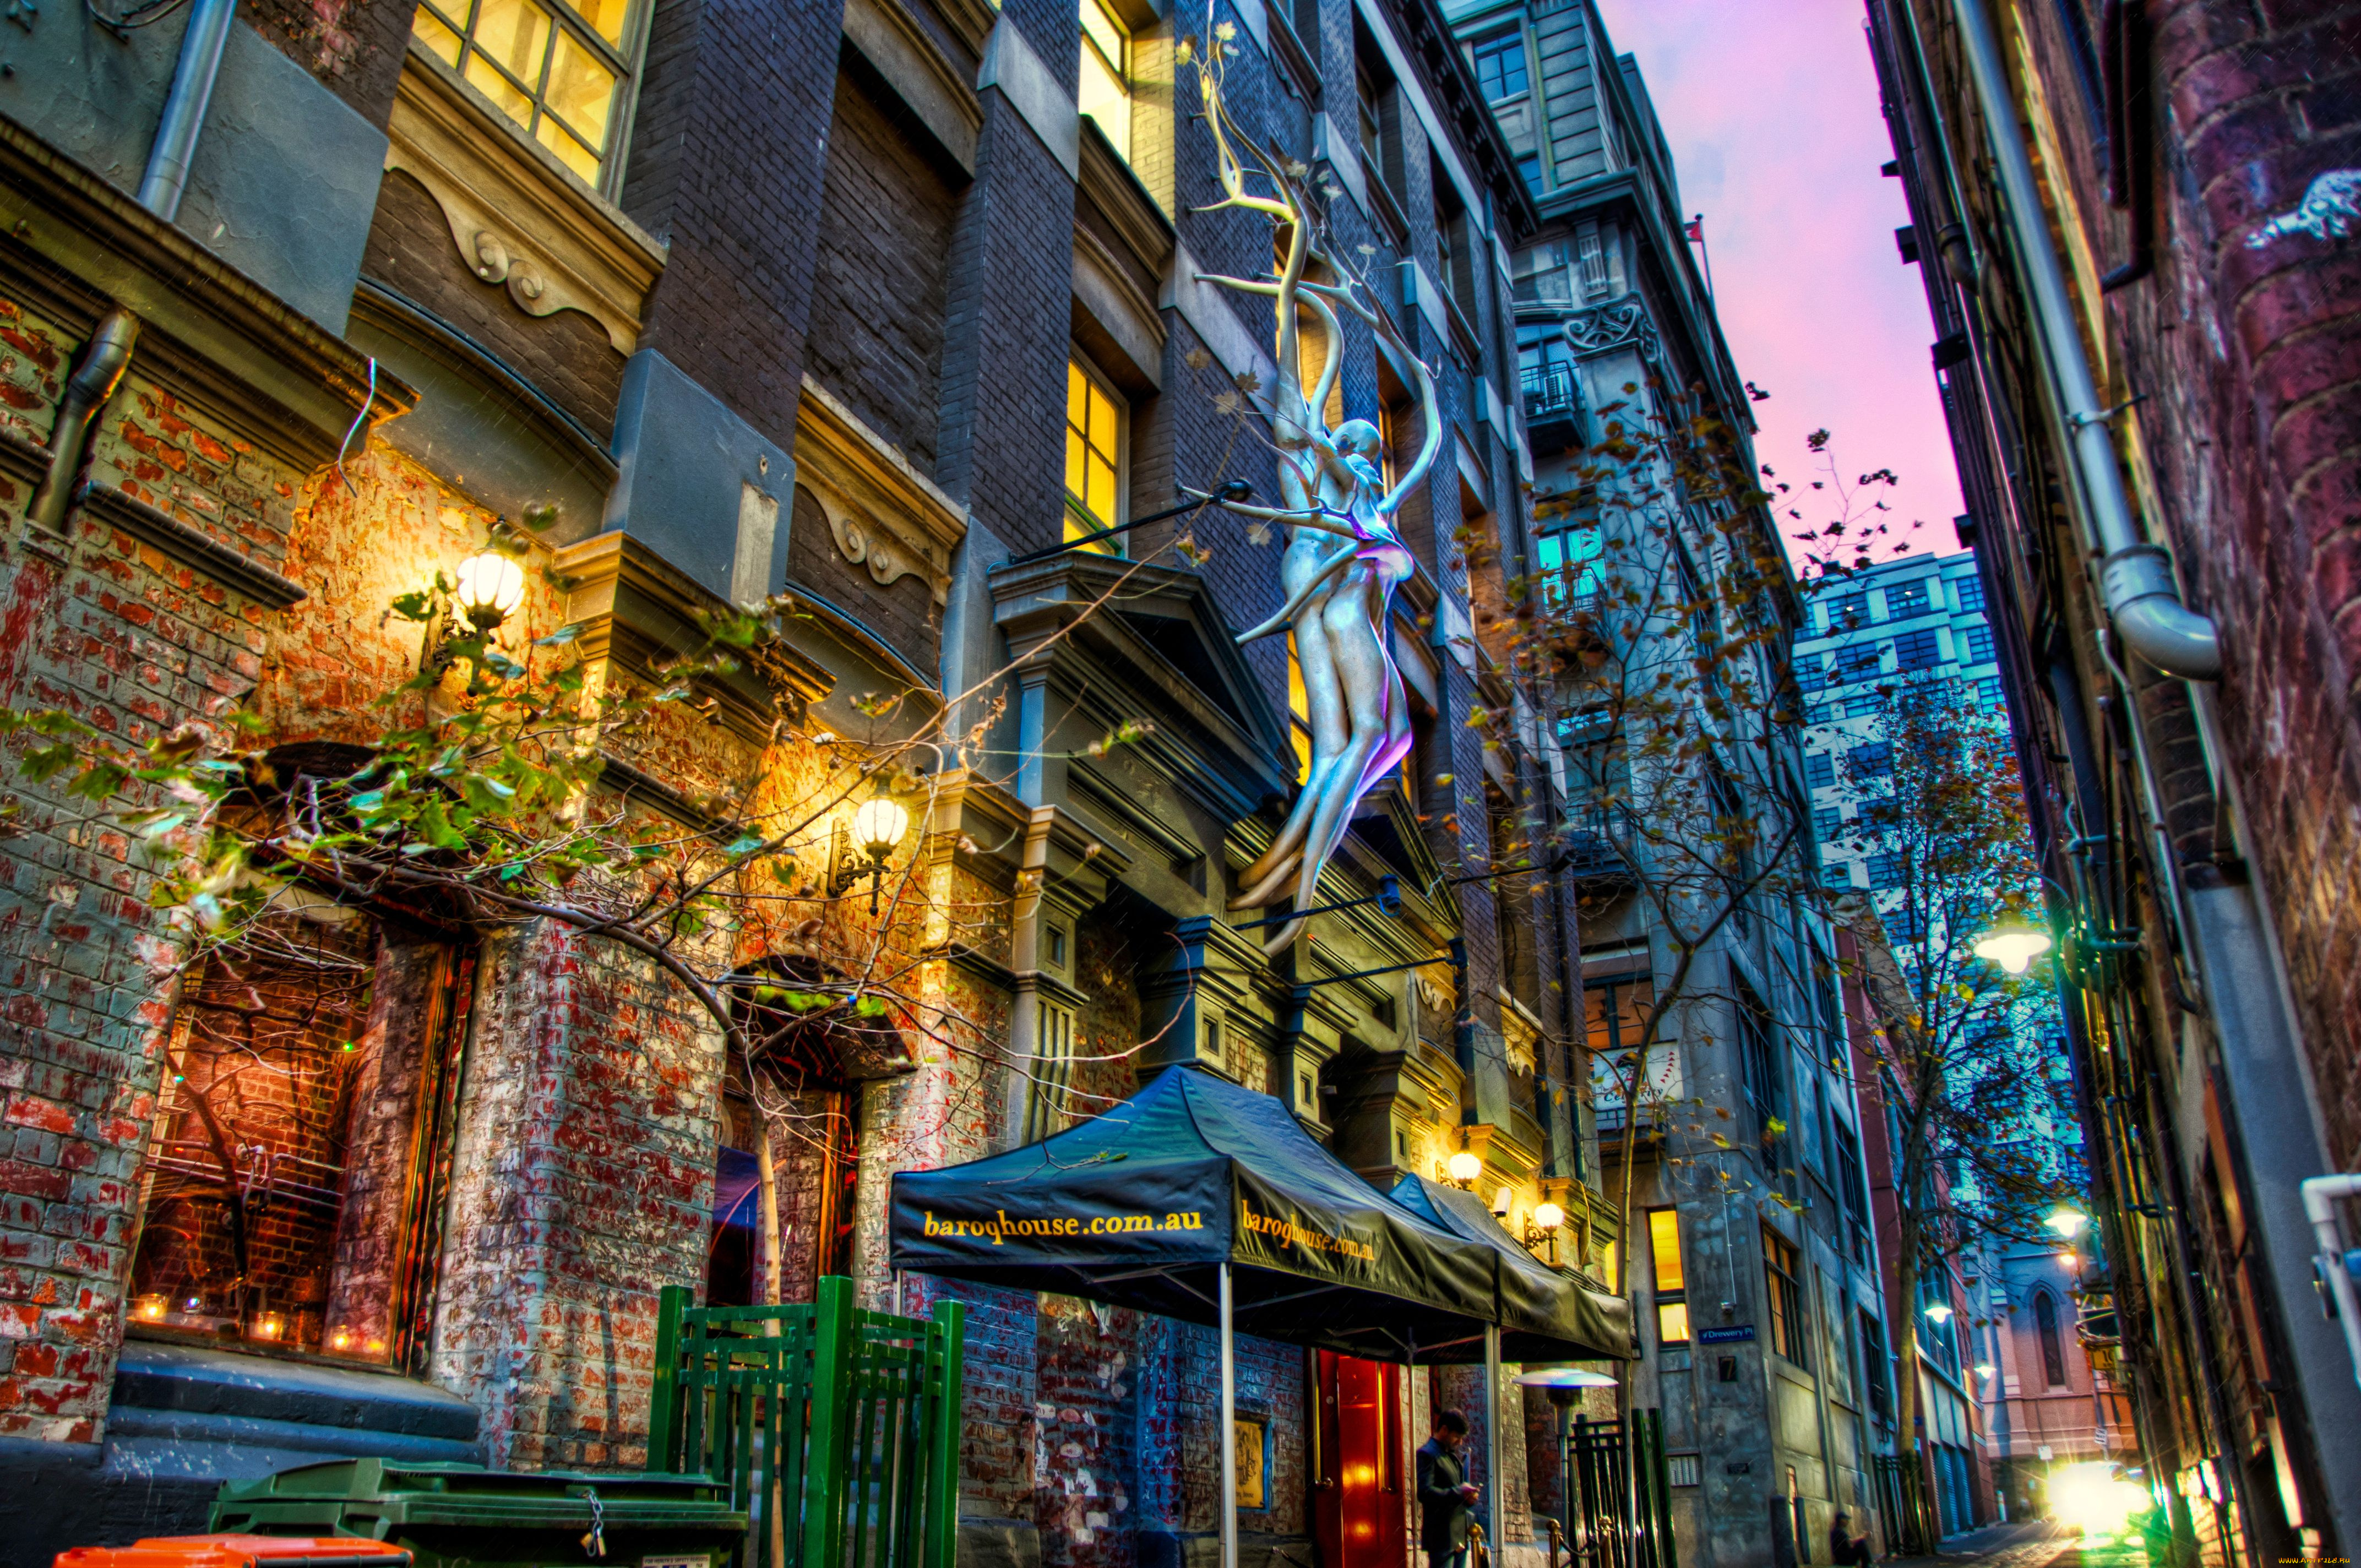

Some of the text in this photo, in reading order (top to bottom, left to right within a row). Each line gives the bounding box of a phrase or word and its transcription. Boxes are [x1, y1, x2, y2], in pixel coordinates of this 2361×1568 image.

[924, 1210, 1204, 1245] baroqhouse.com.au
[1242, 1199, 1375, 1261] baroqhouse.com.au
[1709, 1327, 1754, 1338] Drewery Pl
[1721, 1357, 1735, 1380] 7
